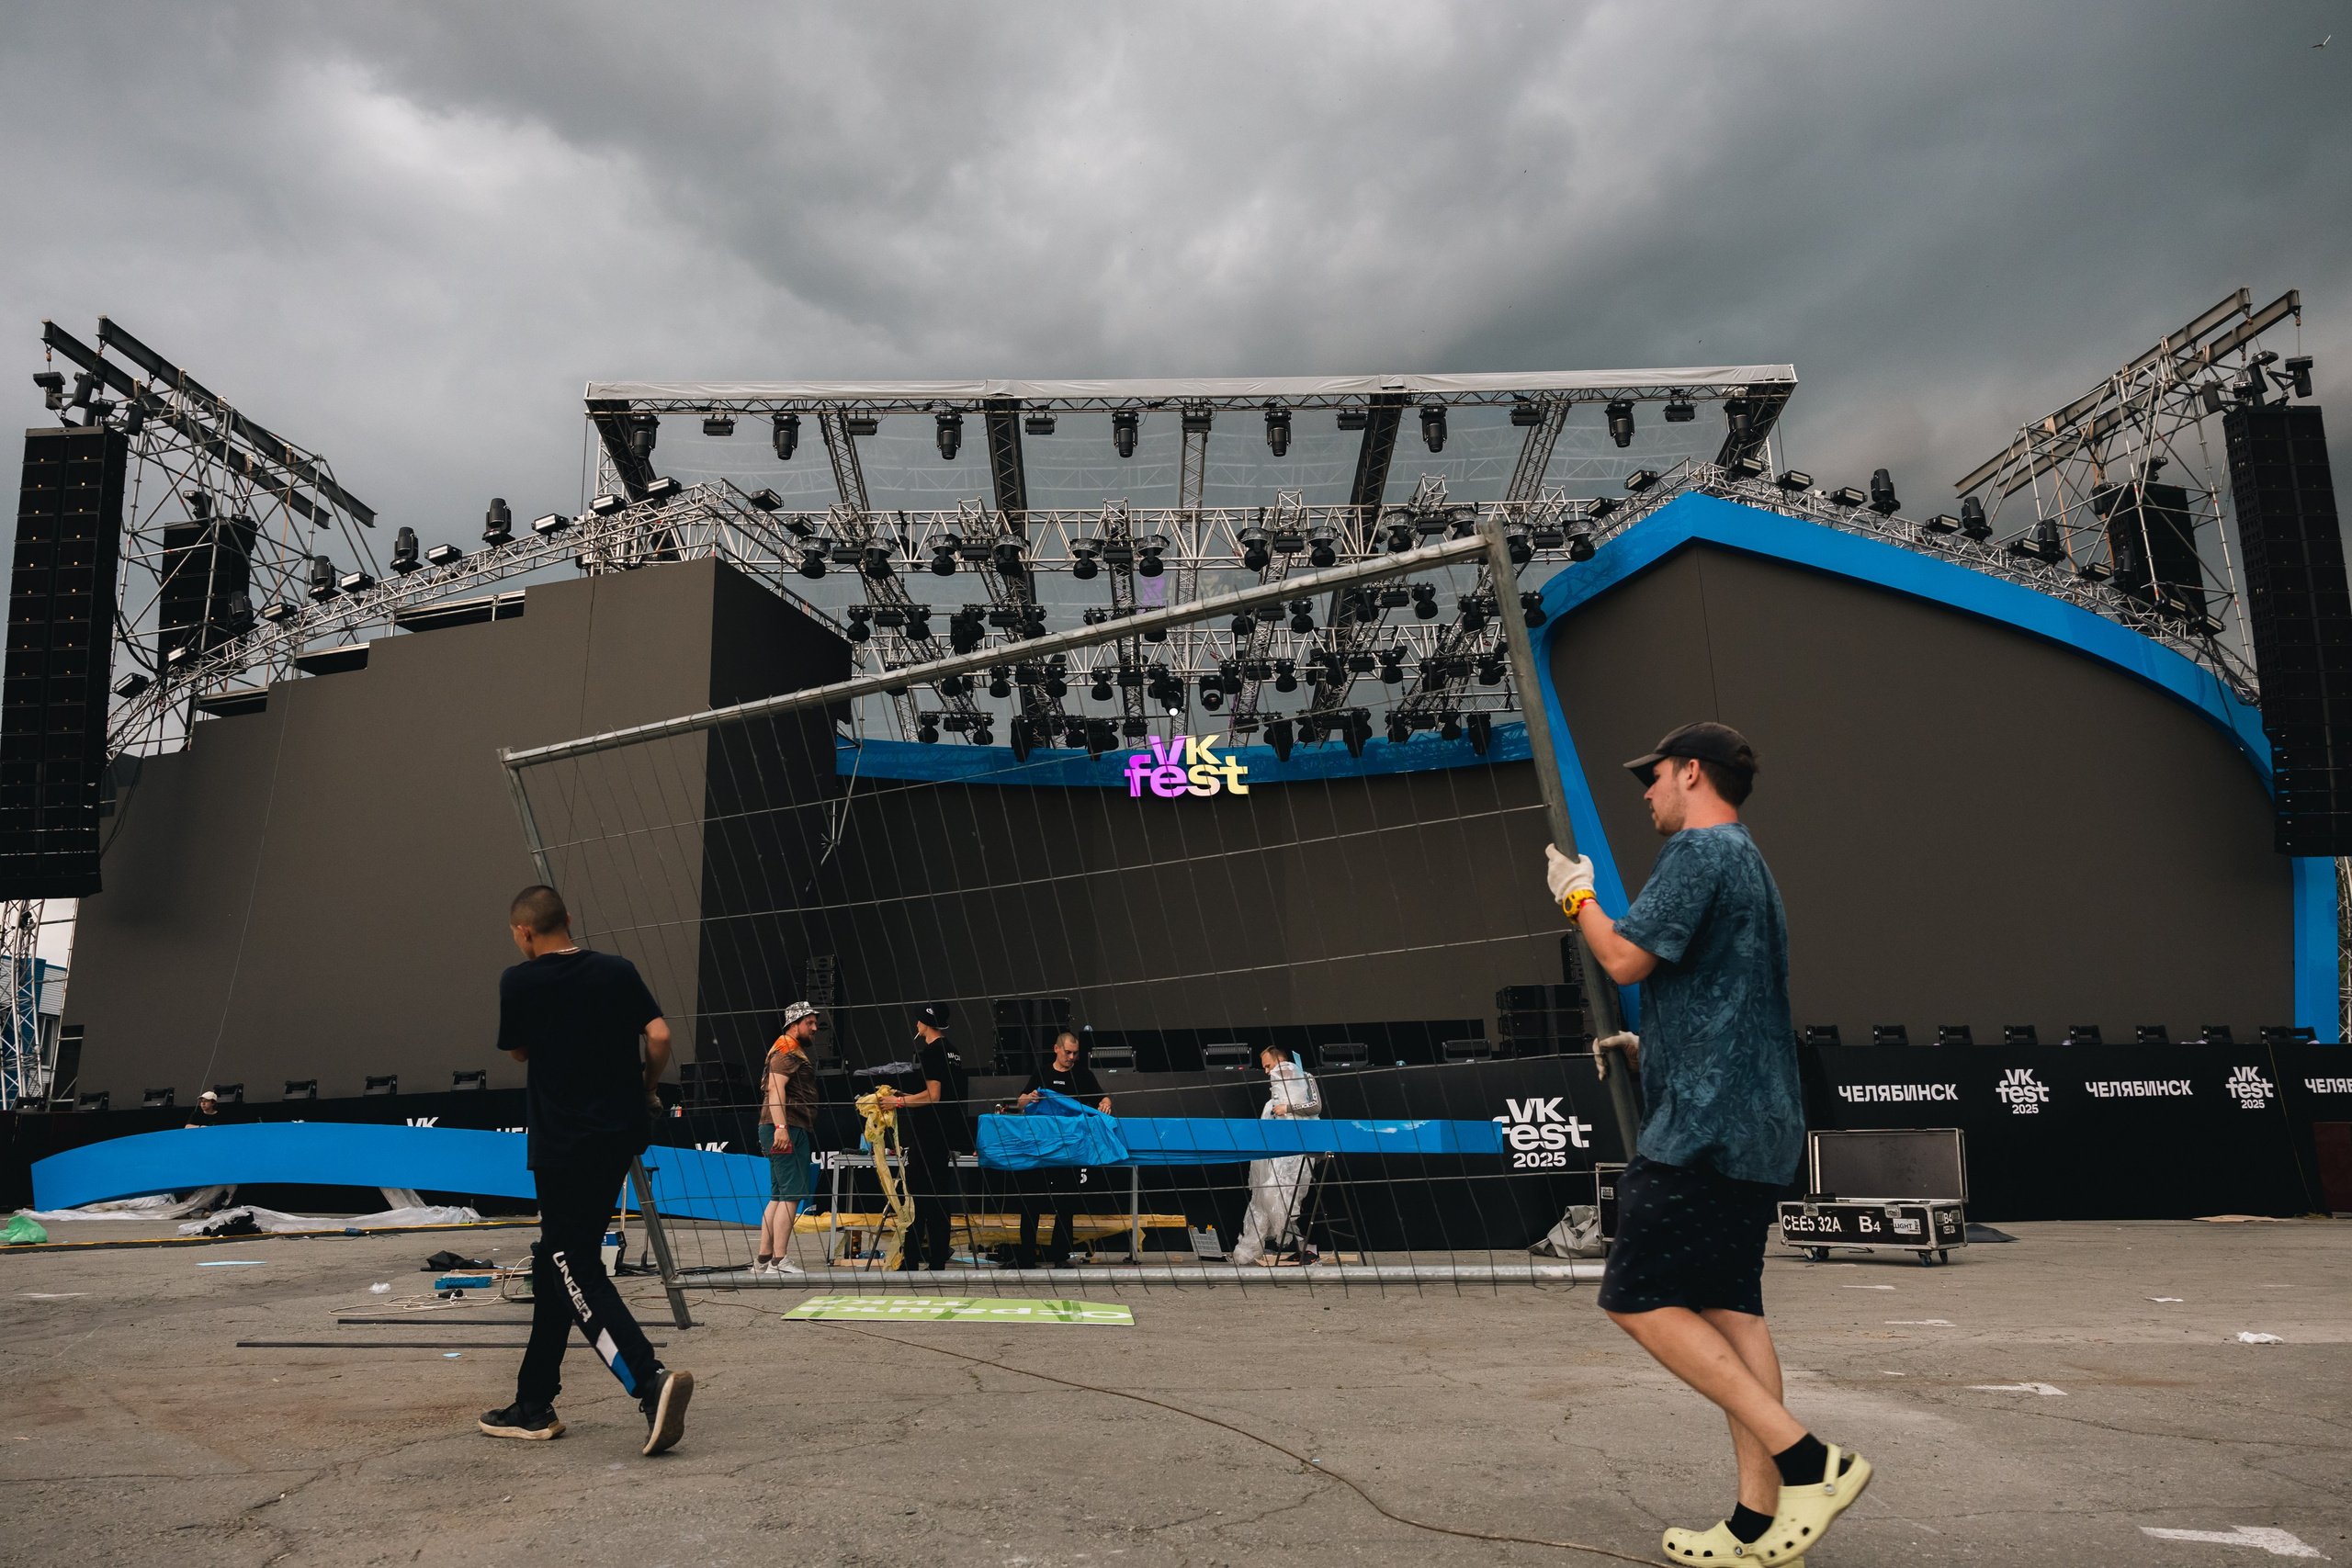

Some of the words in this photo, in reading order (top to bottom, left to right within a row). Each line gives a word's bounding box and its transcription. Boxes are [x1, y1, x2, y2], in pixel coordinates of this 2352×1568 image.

[1148, 735, 1223, 765] VK
[1124, 754, 1250, 798] fest
[2005, 1068, 2036, 1085] VK
[2233, 1066, 2261, 1082] VK
[1838, 1083, 1959, 1102] ЧЕЛЯБИНСК
[1995, 1079, 2050, 1103] fest
[2085, 1079, 2194, 1098] ЧЕЛЯБИНСК
[2225, 1077, 2274, 1099] fest
[1506, 1097, 1566, 1123] VK
[2012, 1103, 2040, 1114] 2025
[2240, 1099, 2266, 1110] 2025
[1512, 1151, 1567, 1168] 2025
[1817, 1216, 1842, 1233] 32A
[1858, 1215, 1882, 1233] B4
[552, 1250, 593, 1323] UNDER
